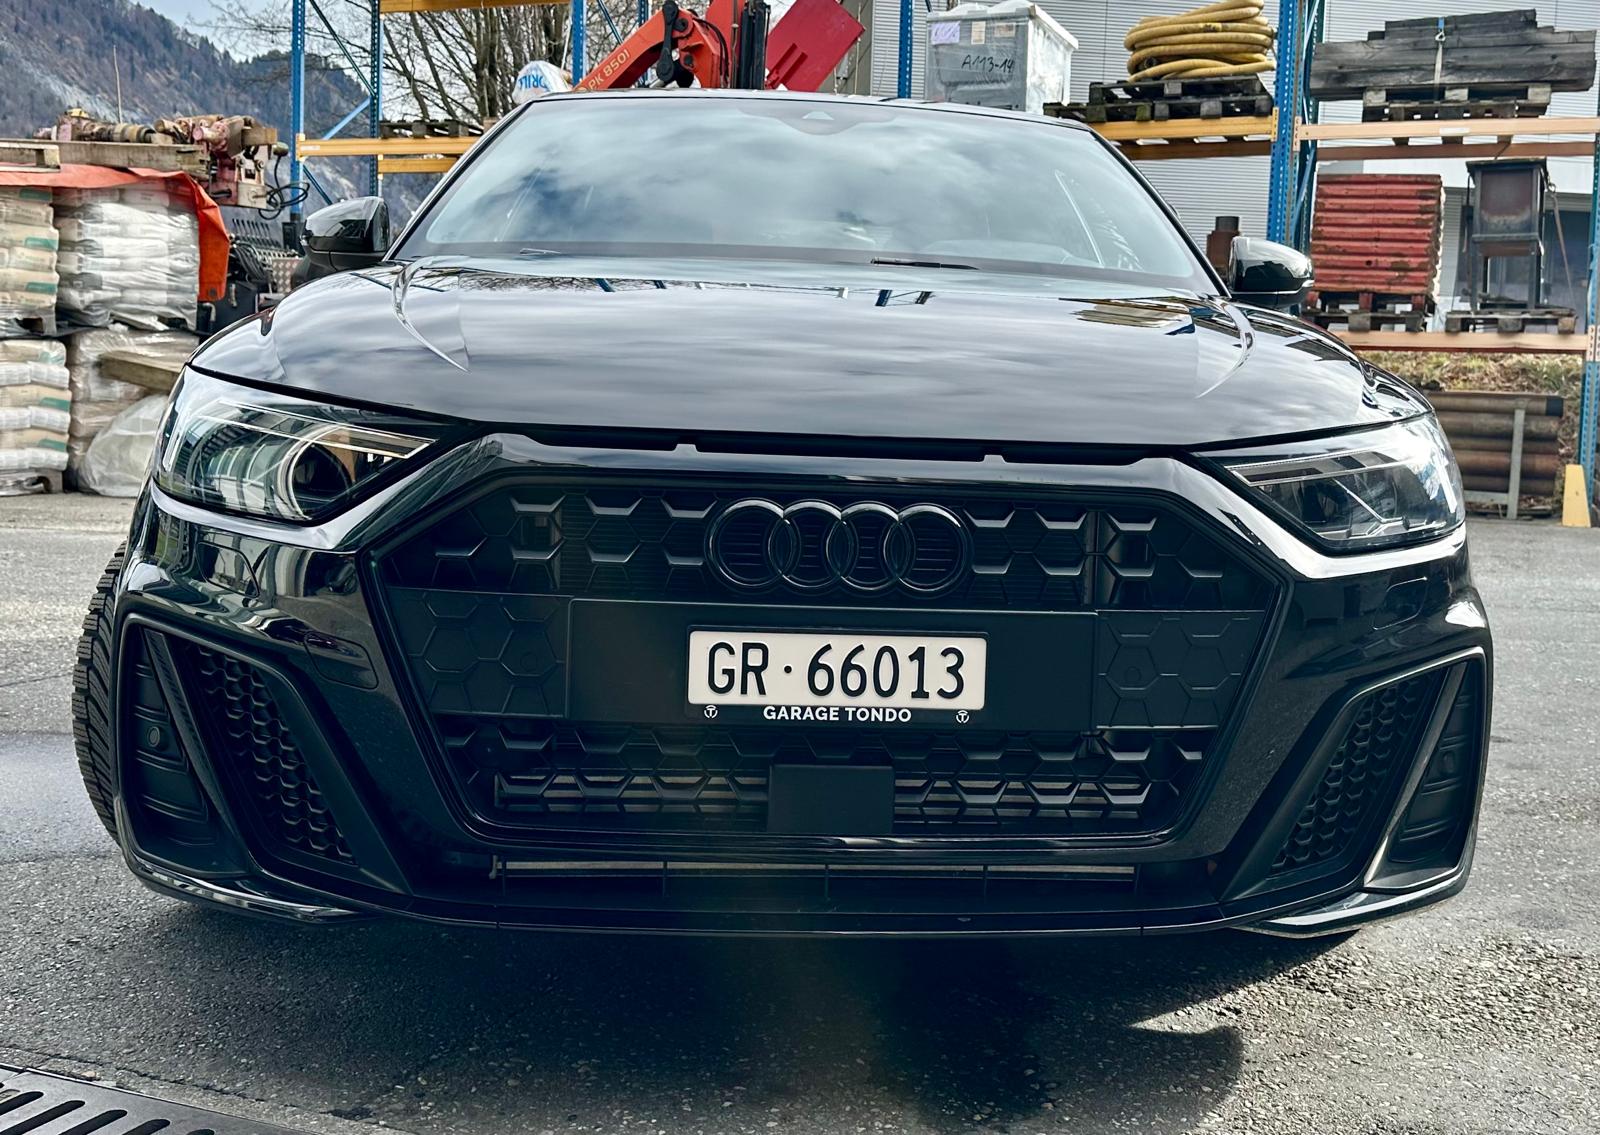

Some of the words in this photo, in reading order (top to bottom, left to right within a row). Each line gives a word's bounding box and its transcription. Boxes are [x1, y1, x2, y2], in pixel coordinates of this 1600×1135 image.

[588, 74, 604, 89] PK
[807, 643, 965, 700] 66013
[763, 705, 839, 721] GARAGE
[845, 707, 912, 723] TONDO
